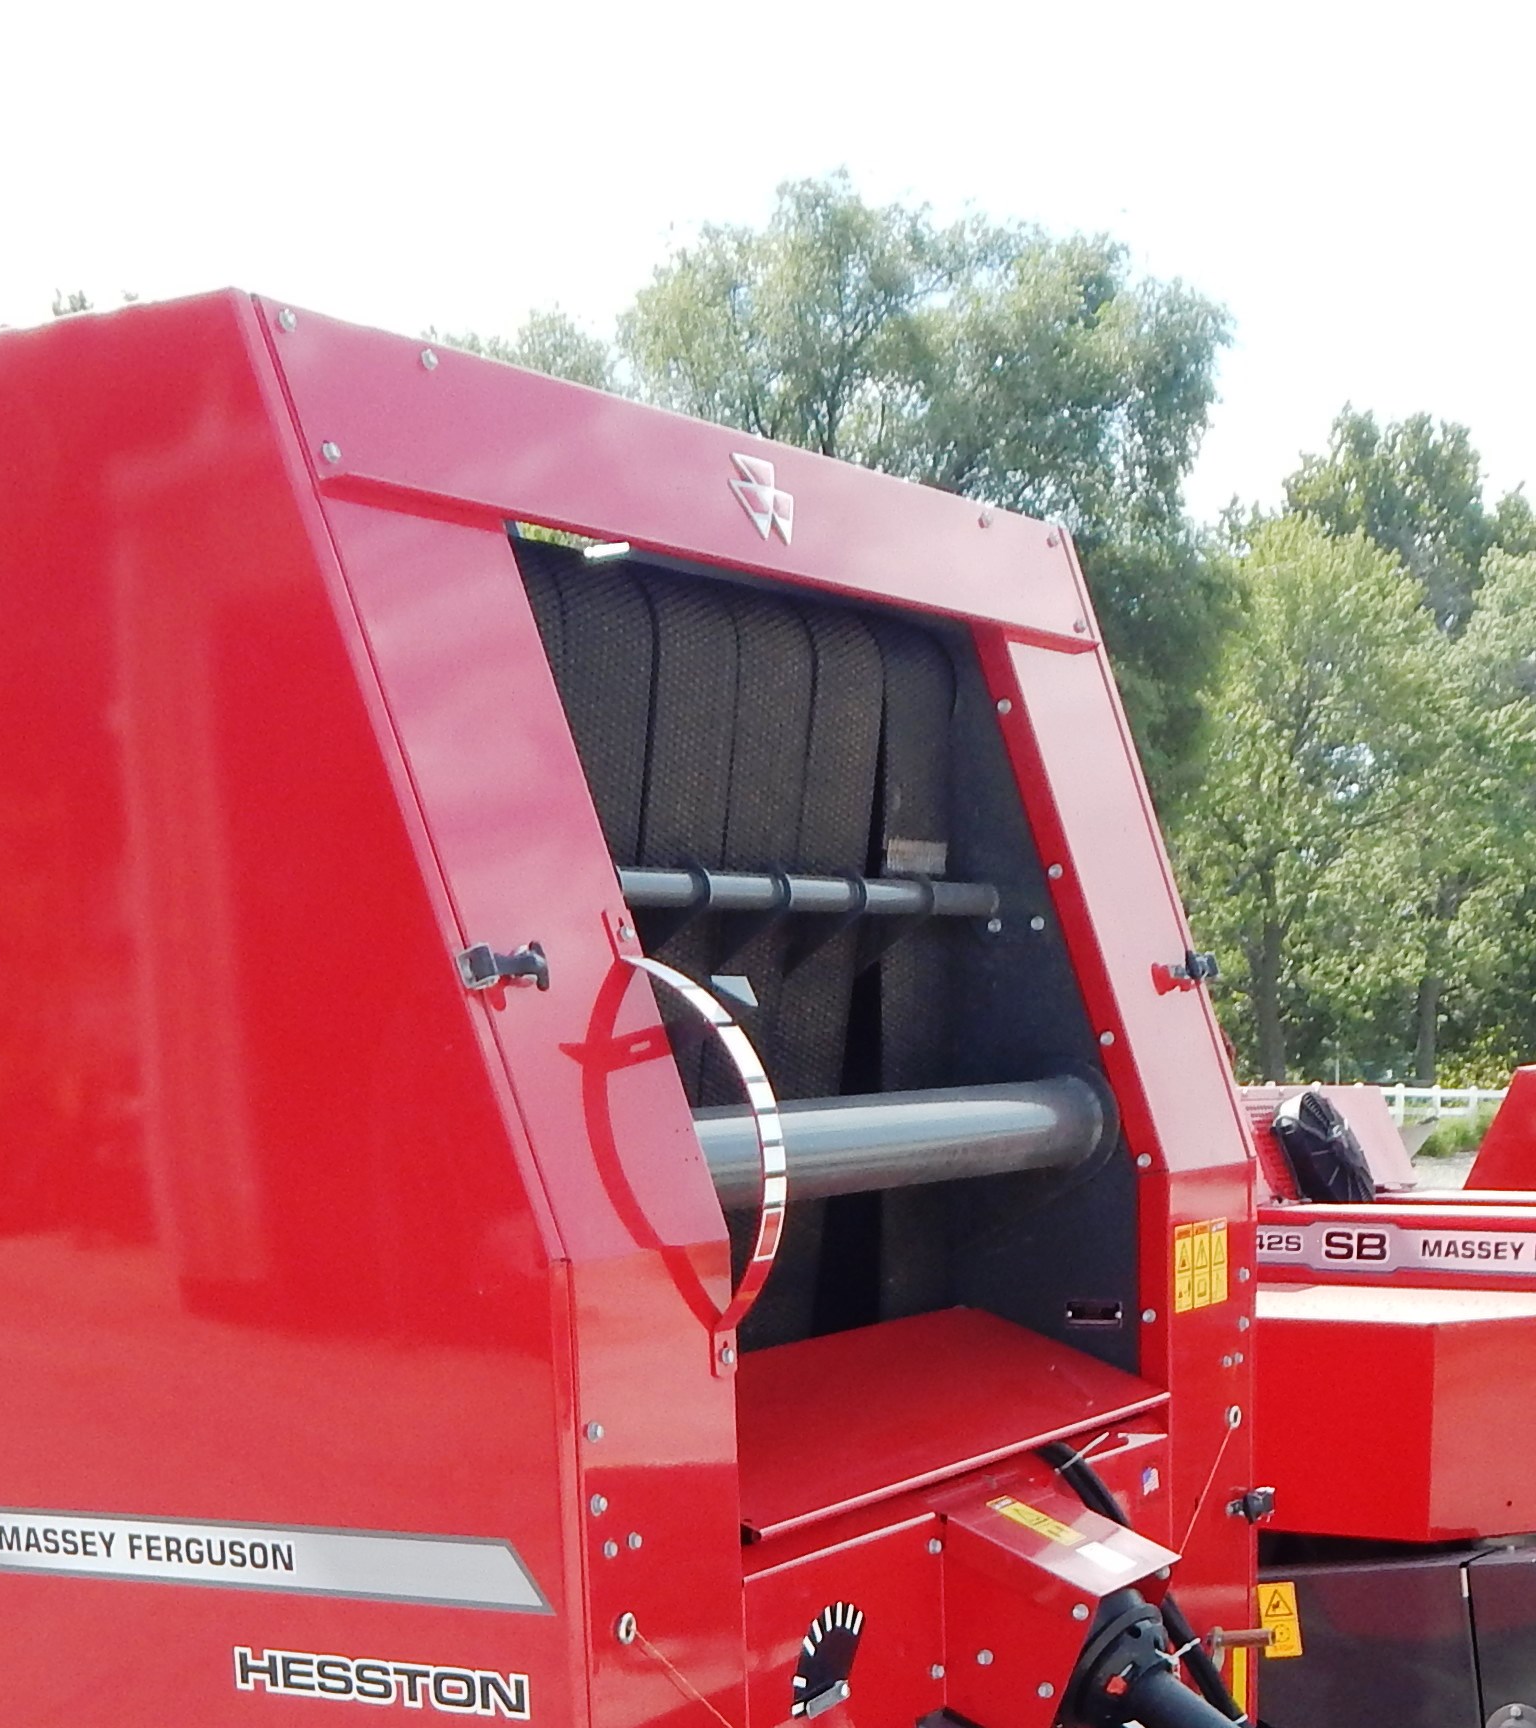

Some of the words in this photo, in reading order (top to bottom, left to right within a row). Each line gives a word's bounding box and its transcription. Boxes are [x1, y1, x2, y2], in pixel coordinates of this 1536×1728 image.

[1323, 1230, 1388, 1261] SB
[1421, 1239, 1524, 1261] MASSEY
[127, 1532, 295, 1572] FERGUSON
[236, 1648, 529, 1718] HESSTON
